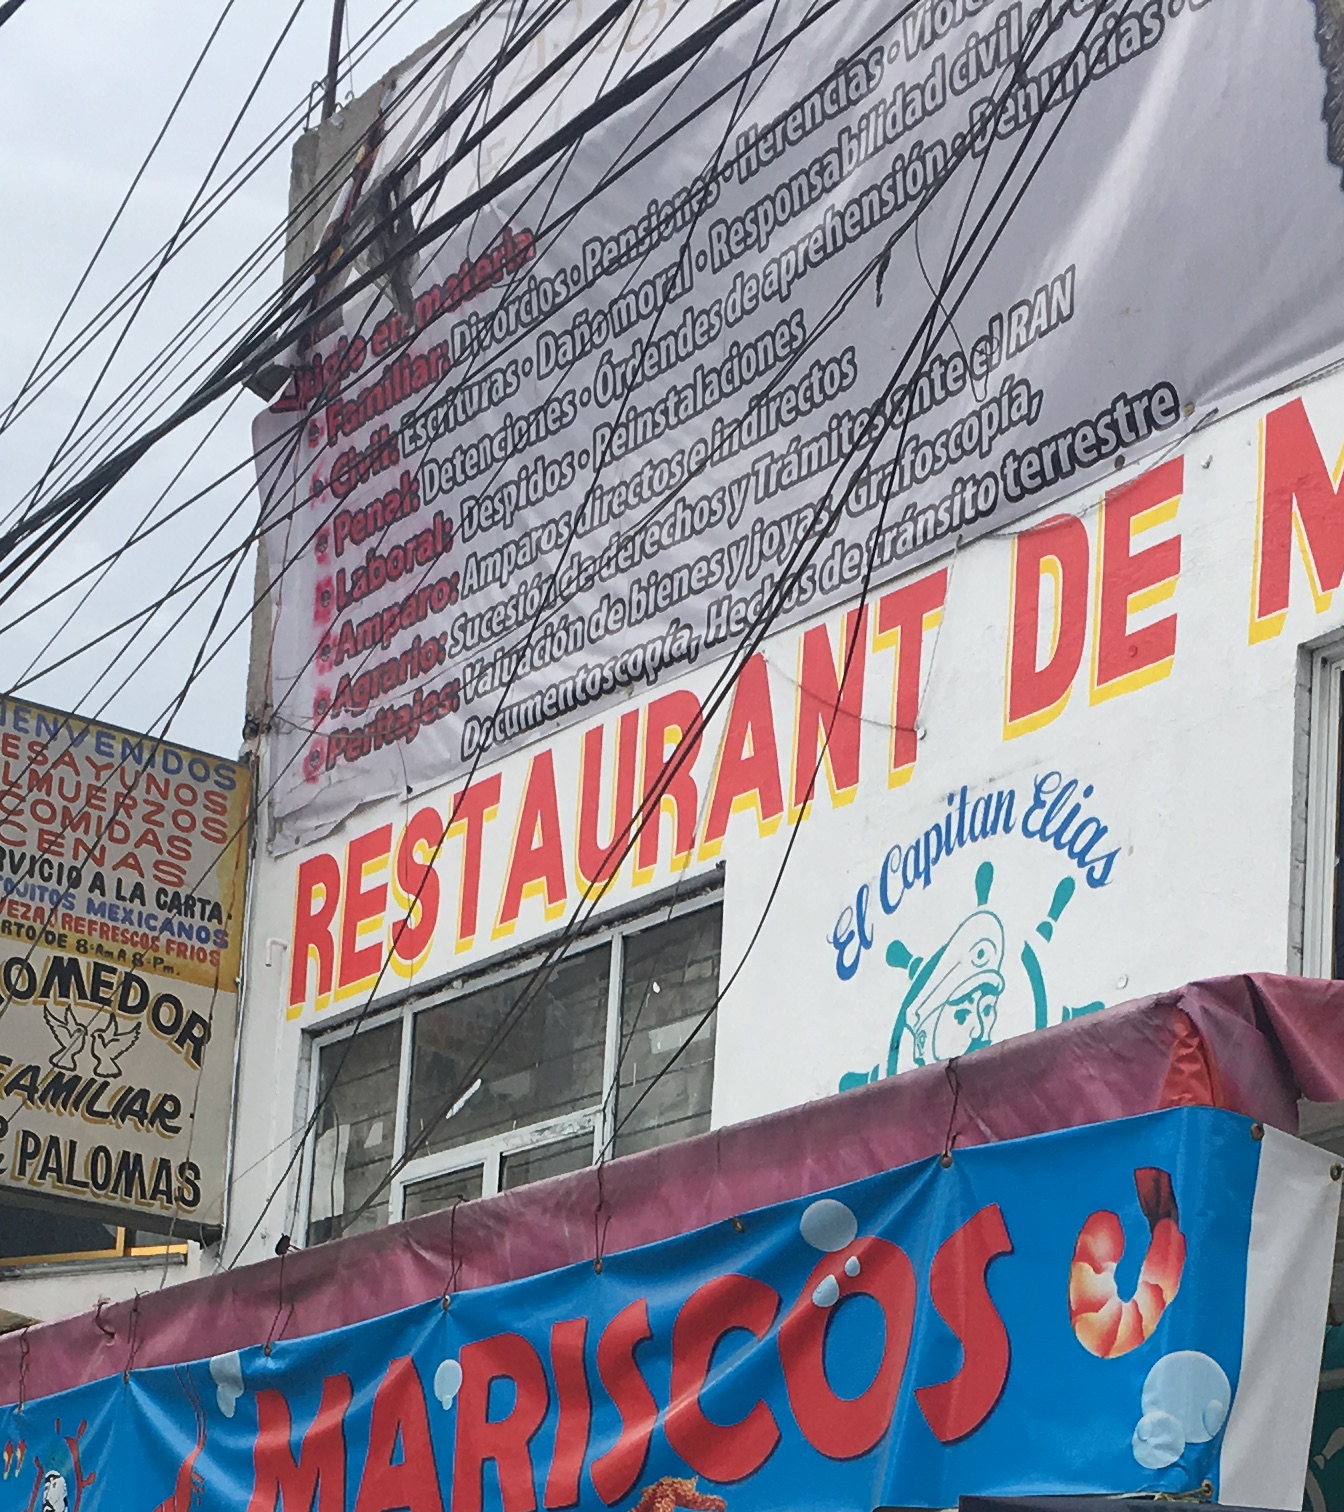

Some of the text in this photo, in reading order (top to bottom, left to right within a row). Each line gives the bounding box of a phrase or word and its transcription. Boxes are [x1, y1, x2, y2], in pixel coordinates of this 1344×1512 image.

[334, 3, 1166, 557] Penal: Detenciones Órdendes de aprehensión Denuncias
[399, 359, 522, 459] Escrituras
[535, 309, 607, 380] Daño
[609, 244, 694, 338] moral
[708, 53, 948, 274] Responsabilidad
[949, 1, 1023, 96] civil
[415, 227, 537, 328] materia
[451, 268, 571, 369] Divorcios
[582, 170, 721, 287] Pensiones
[736, 46, 884, 184] Herencias
[330, 629, 449, 721] Agrario:
[448, 566, 558, 658] Sucesión
[557, 550, 596, 599] de
[597, 486, 727, 585] derechos
[728, 472, 754, 531] y
[753, 396, 886, 504] Trámites
[969, 312, 1005, 382] el
[1006, 262, 1077, 360] RAN
[334, 346, 859, 666] Amparo: Amparos directos e indirectos
[335, 308, 807, 611] Laboral: Despidos Reinstalaciones
[461, 381, 1182, 763] Documentoscopía, Hechos de tránsito terrestre
[286, 565, 950, 1022] RESTAURANT
[1003, 456, 1184, 741] DE
[460, 608, 585, 706] Valuación
[588, 592, 627, 641] de
[627, 549, 727, 628] bienes
[725, 535, 747, 592] y
[43, 928, 69, 950] DE
[60, 912, 161, 954] REFRESCOS
[165, 938, 221, 968] FRIOS
[85, 896, 229, 950] MEXICANOS
[87, 871, 106, 898] A
[115, 877, 147, 908] LA
[827, 884, 875, 981] El
[879, 785, 1017, 916] Capitan
[11, 1128, 202, 1215] PALOMAS
